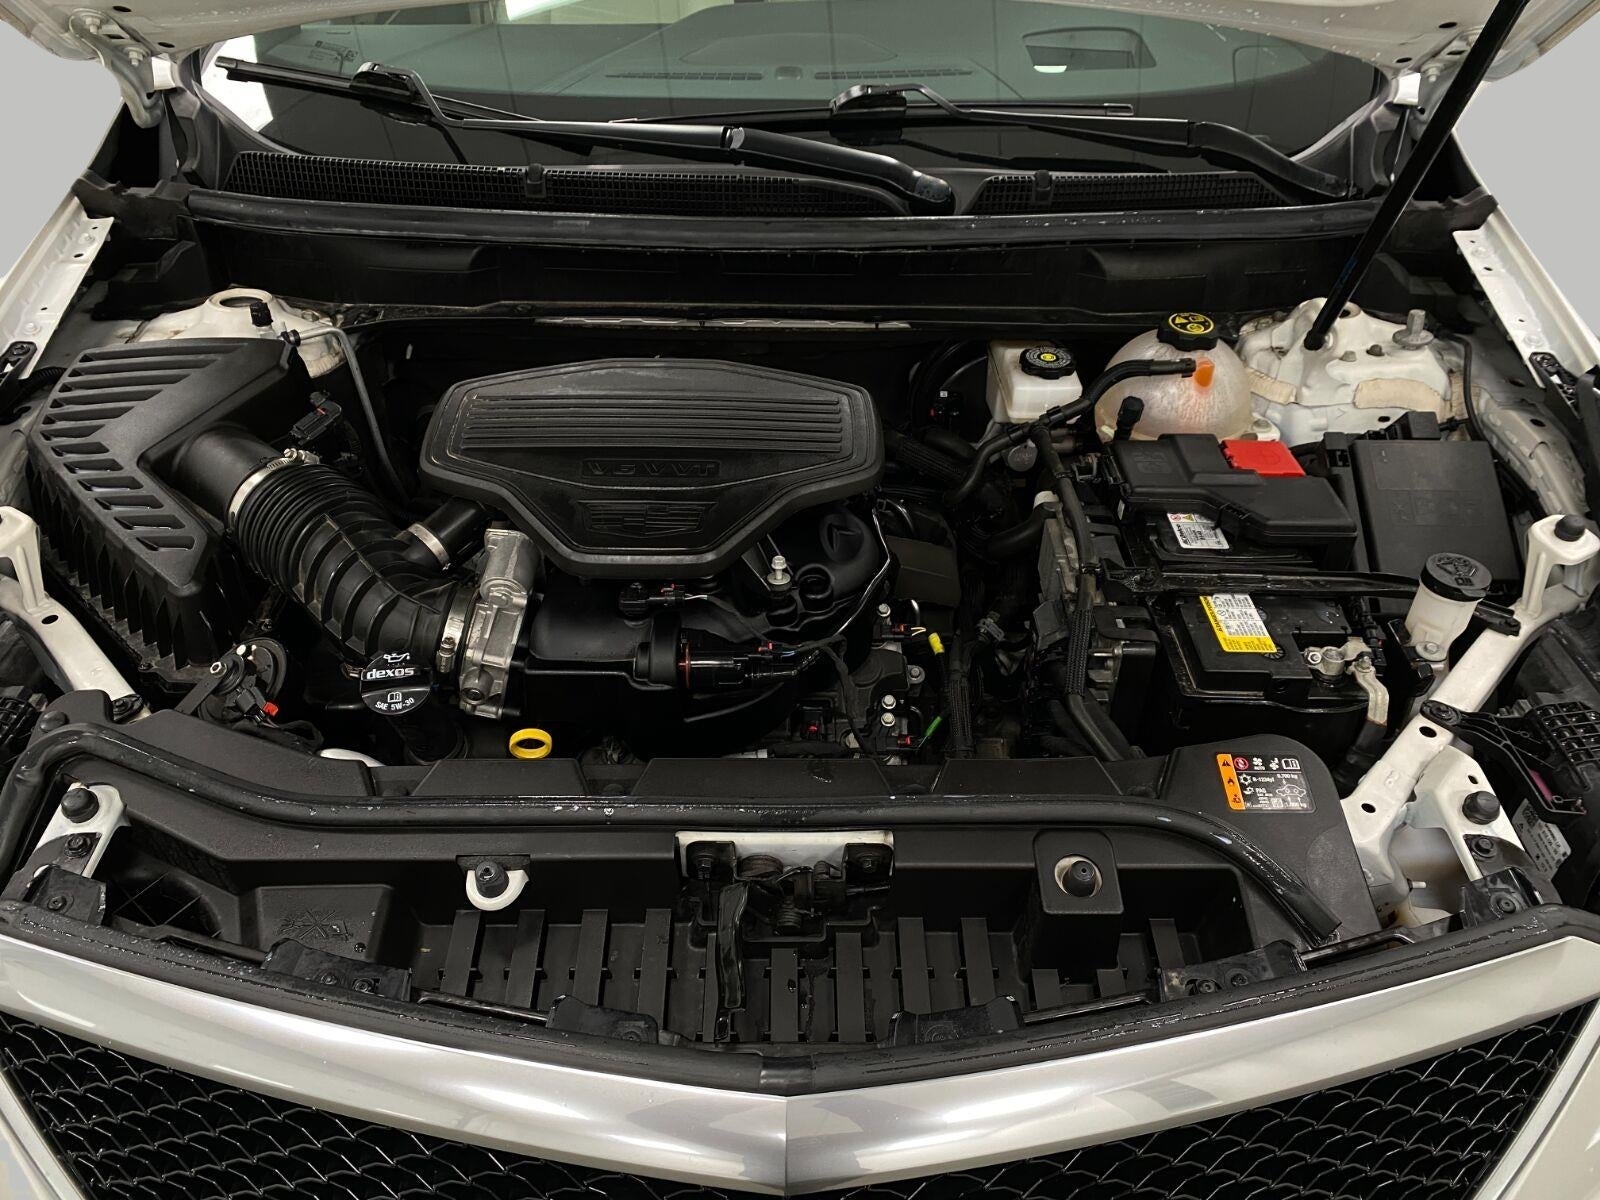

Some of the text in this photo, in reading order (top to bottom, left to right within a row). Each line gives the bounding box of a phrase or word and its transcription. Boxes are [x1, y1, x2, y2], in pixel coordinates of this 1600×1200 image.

[587, 462, 716, 476] V6 VVT
[366, 667, 415, 680] dexos
[375, 697, 415, 711] SAE 5W-30
